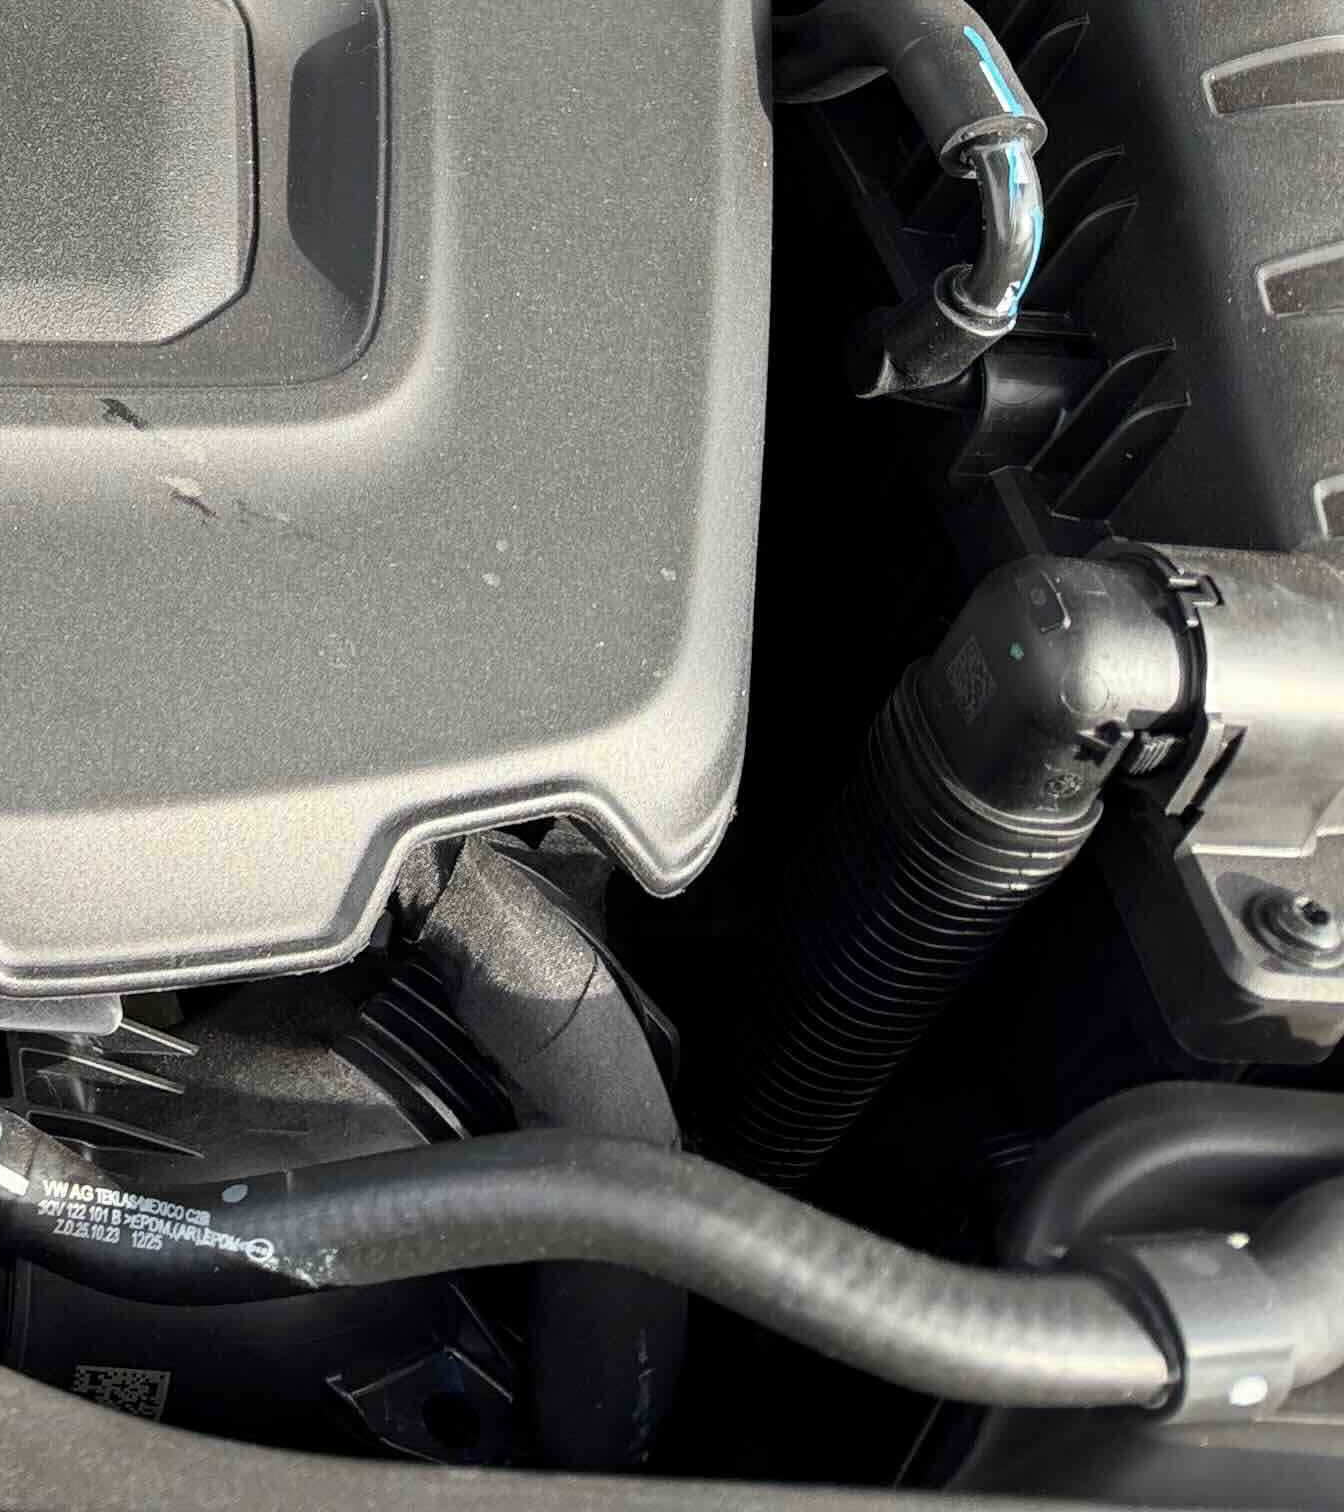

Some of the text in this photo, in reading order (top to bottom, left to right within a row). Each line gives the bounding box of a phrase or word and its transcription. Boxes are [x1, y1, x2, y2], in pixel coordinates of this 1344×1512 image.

[43, 1179, 71, 1198] VW
[72, 1182, 95, 1202] AG
[66, 1204, 88, 1222] 122
